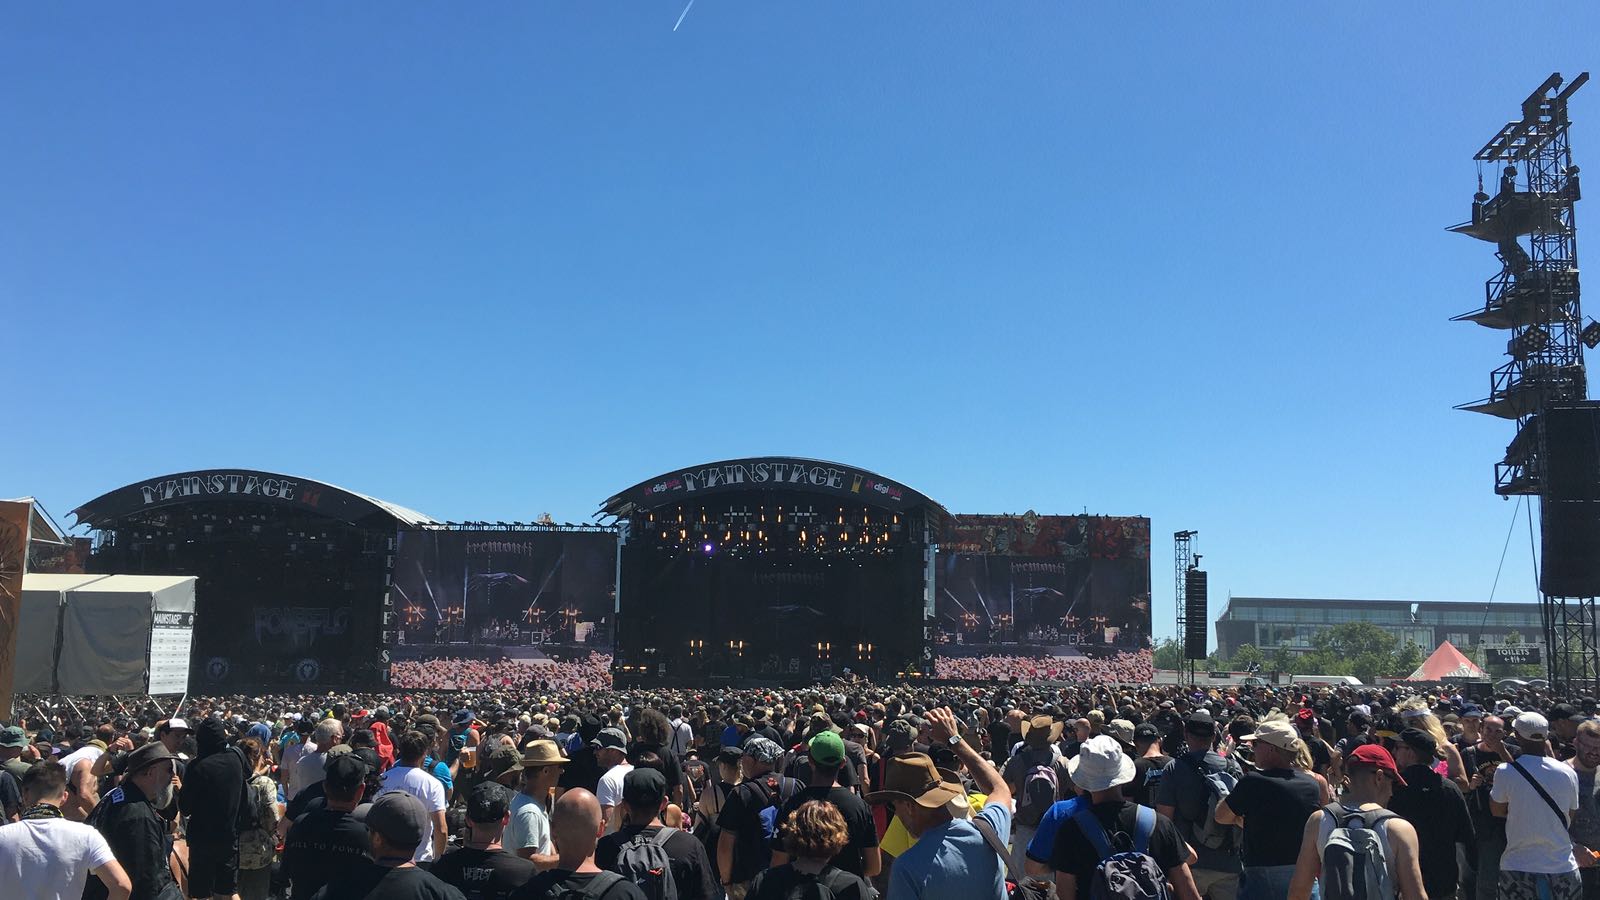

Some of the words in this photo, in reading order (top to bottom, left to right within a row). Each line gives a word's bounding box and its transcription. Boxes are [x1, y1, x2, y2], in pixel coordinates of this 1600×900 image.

[140, 474, 298, 505] MAINSTAGE
[682, 463, 846, 492] MAINSTAGE
[1496, 648, 1530, 656] TOILETS
